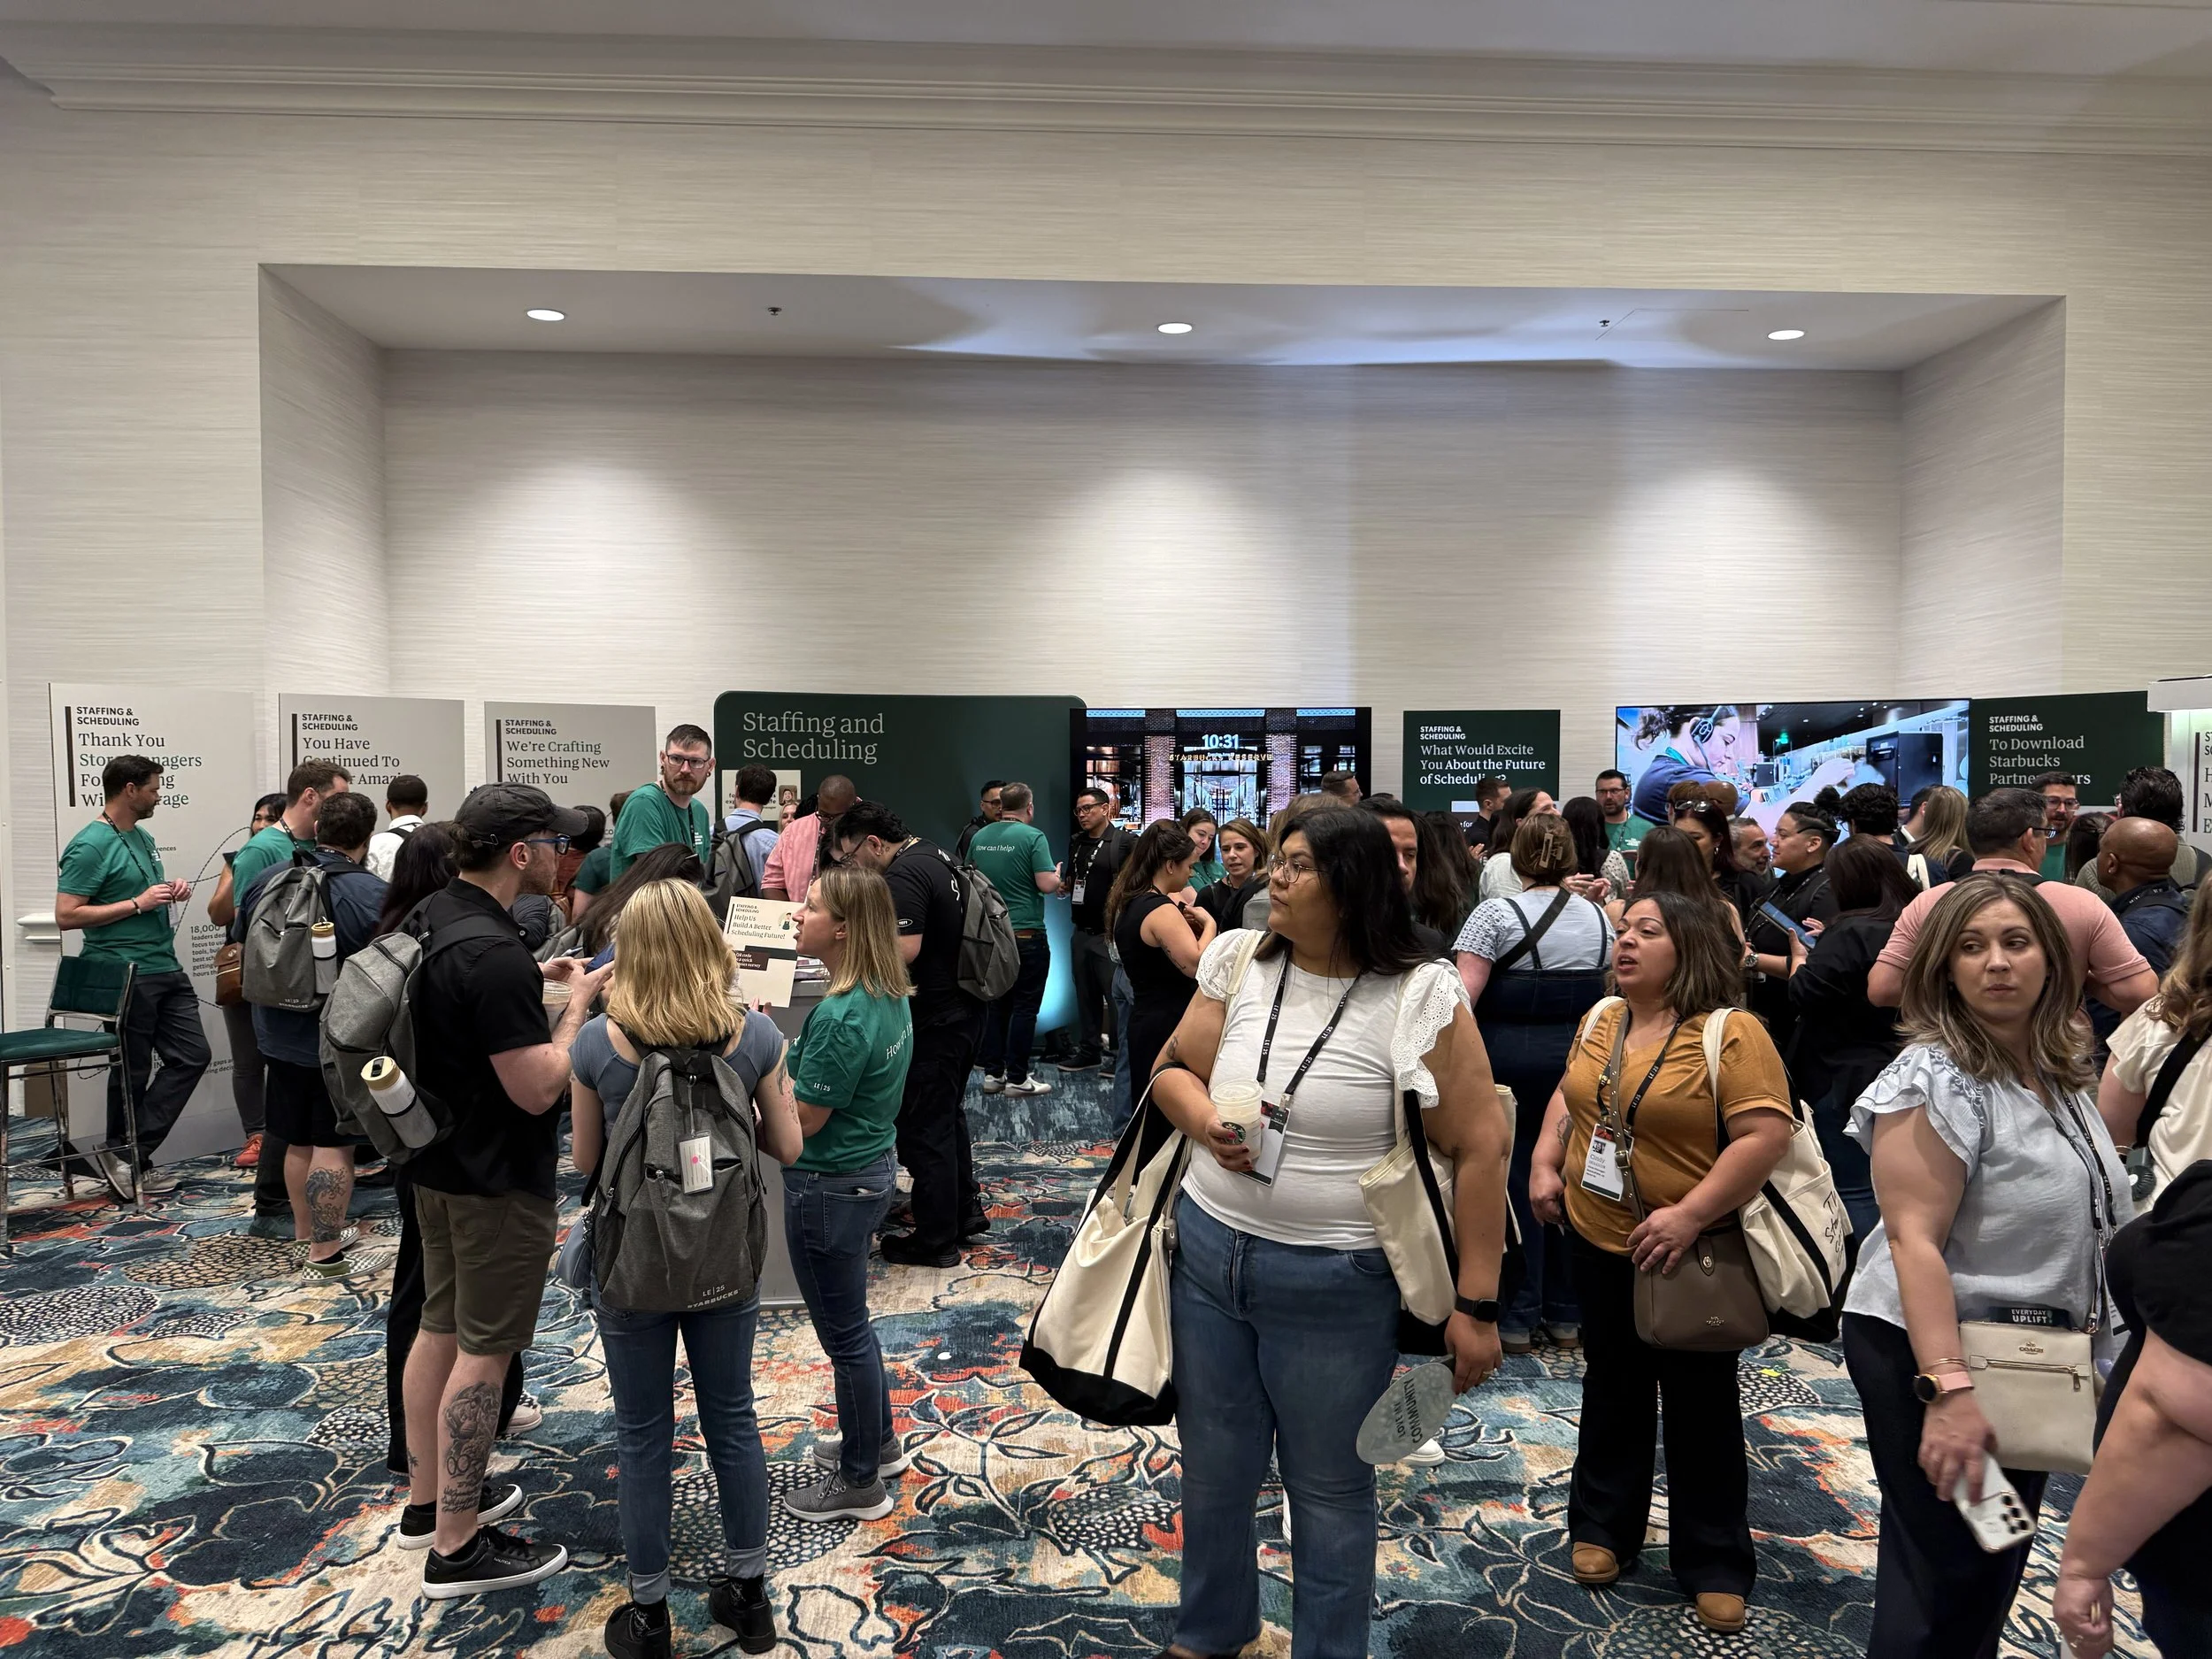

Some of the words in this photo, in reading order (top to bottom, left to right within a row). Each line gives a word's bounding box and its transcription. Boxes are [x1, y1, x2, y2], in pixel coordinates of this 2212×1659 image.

[77, 706, 124, 716] STAFFING
[302, 713, 345, 722] STAFFING
[77, 717, 140, 726] SCHEDULING
[743, 711, 835, 738] Staffing
[840, 713, 885, 733] and
[1989, 715, 2030, 724] STAFFING
[1989, 724, 2043, 733] SCHEDULING
[79, 733, 132, 747] Thank
[134, 734, 165, 747] You
[303, 738, 331, 749] You
[334, 738, 370, 749] Have
[1202, 733, 1240, 749] 10:31
[1989, 739, 2008, 750] To
[2010, 735, 2085, 750] Download
[507, 741, 546, 752] We're
[548, 741, 601, 755] Crafting
[743, 738, 878, 765] Scheduling
[1420, 744, 1452, 756] What
[1455, 744, 1494, 756] Would
[1497, 744, 1534, 755] Excite
[381, 757, 400, 767] To
[507, 757, 580, 771] Something
[582, 758, 610, 768] New
[1420, 760, 1443, 770] You
[1445, 758, 1480, 770] About
[1482, 759, 1502, 770] the
[1505, 759, 1546, 770] Future
[1989, 754, 2061, 767] Starbucks
[81, 774, 102, 787] Fo
[507, 773, 540, 784] With
[542, 773, 568, 784] You
[1420, 773, 1432, 784] of
[1989, 772, 2039, 785] Partne
[1403, 1379, 1423, 1443] COMMUNITY
[1395, 1416, 1406, 1438] LOVE
